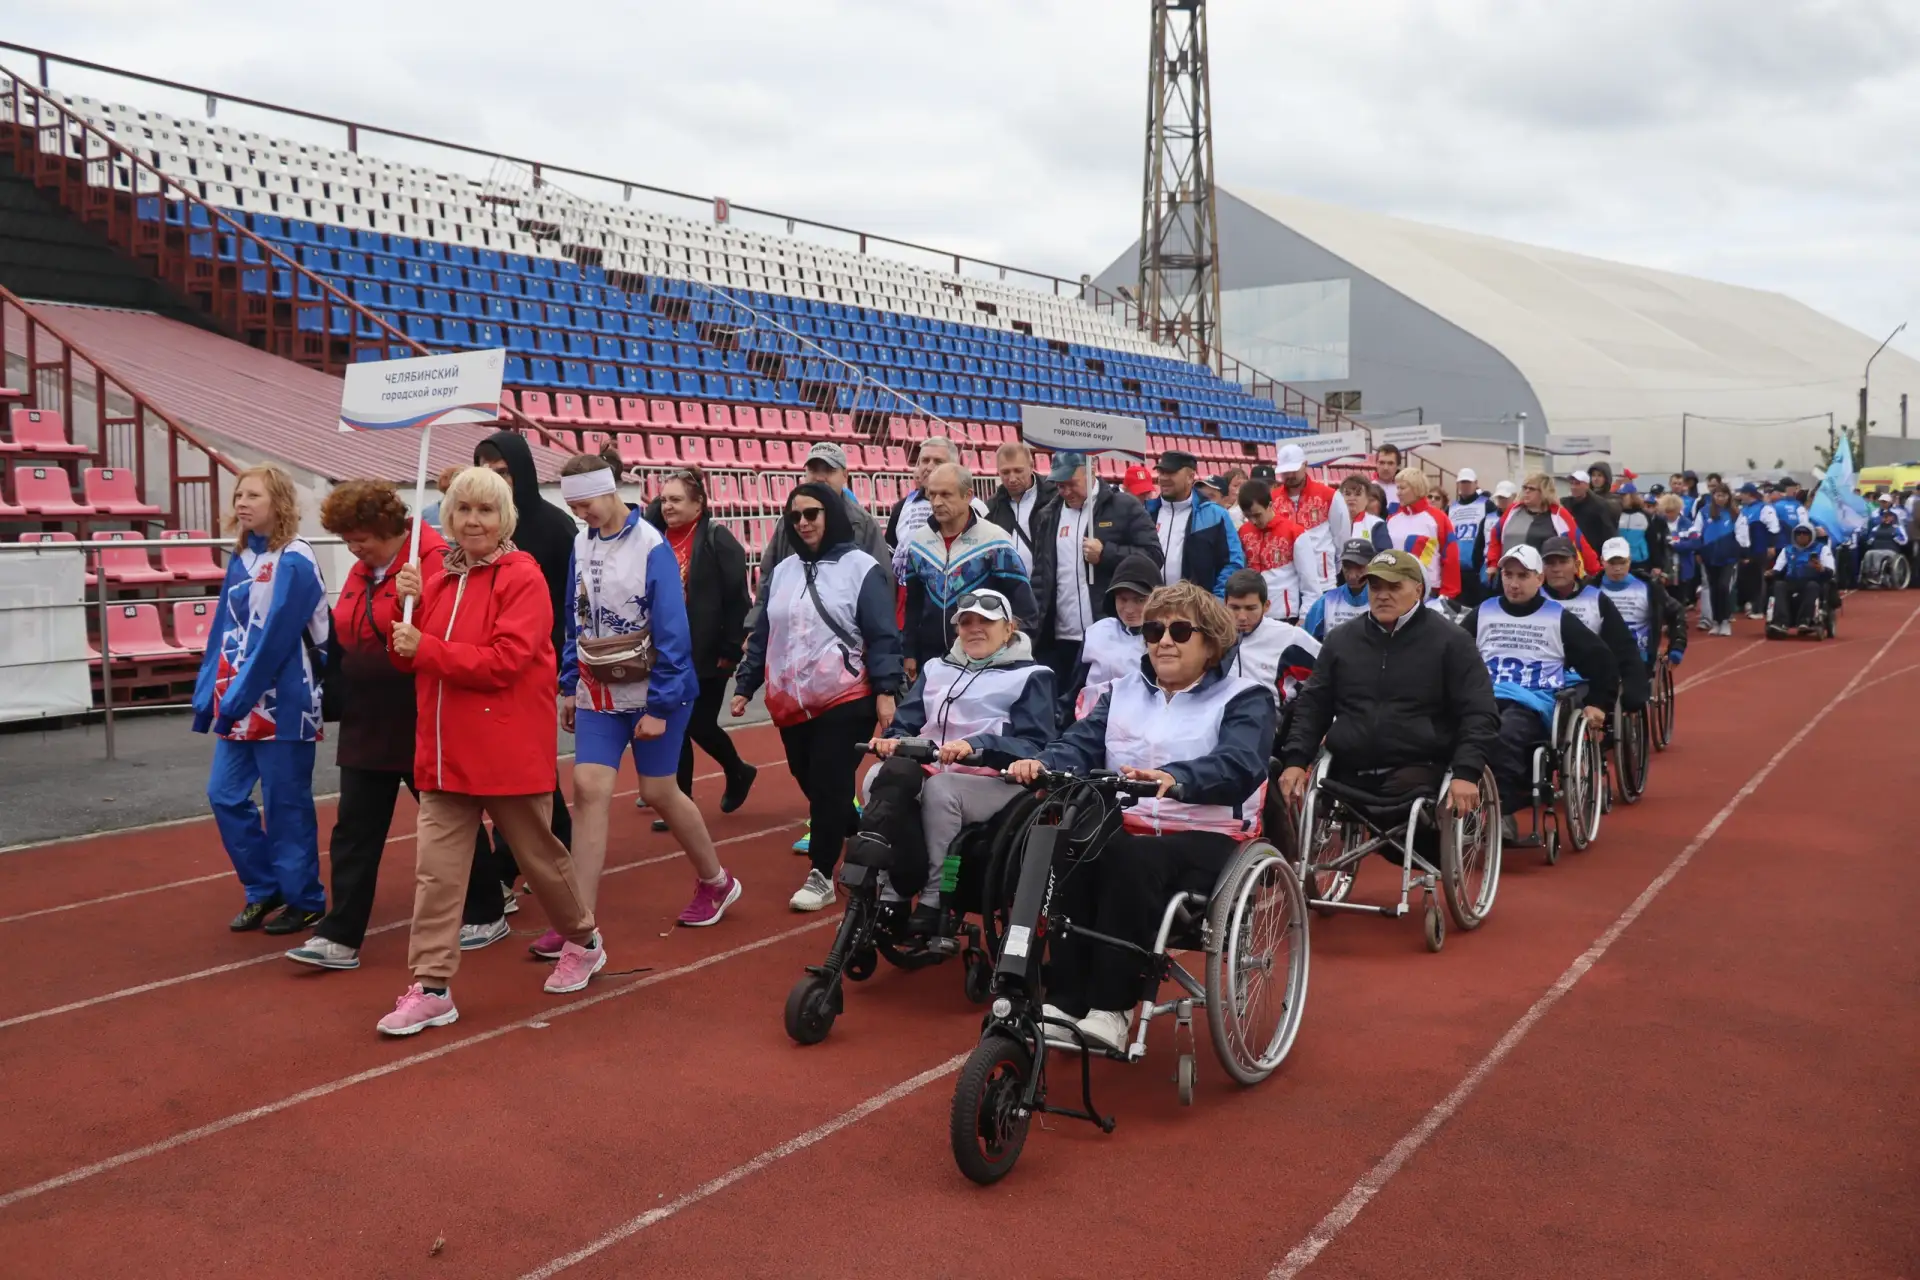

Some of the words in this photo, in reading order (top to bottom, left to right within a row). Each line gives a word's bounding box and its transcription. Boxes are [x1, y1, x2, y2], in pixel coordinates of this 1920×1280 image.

[716, 199, 727, 221] D
[385, 365, 460, 384] ЧЕЛЯБИНСКИЙ
[381, 387, 429, 402] городской
[431, 385, 460, 399] округ
[1060, 417, 1108, 430] КОПЕЙСКИЙ
[1053, 428, 1092, 439] городской
[1093, 433, 1114, 442] округ
[1042, 865, 1056, 918] SMART
